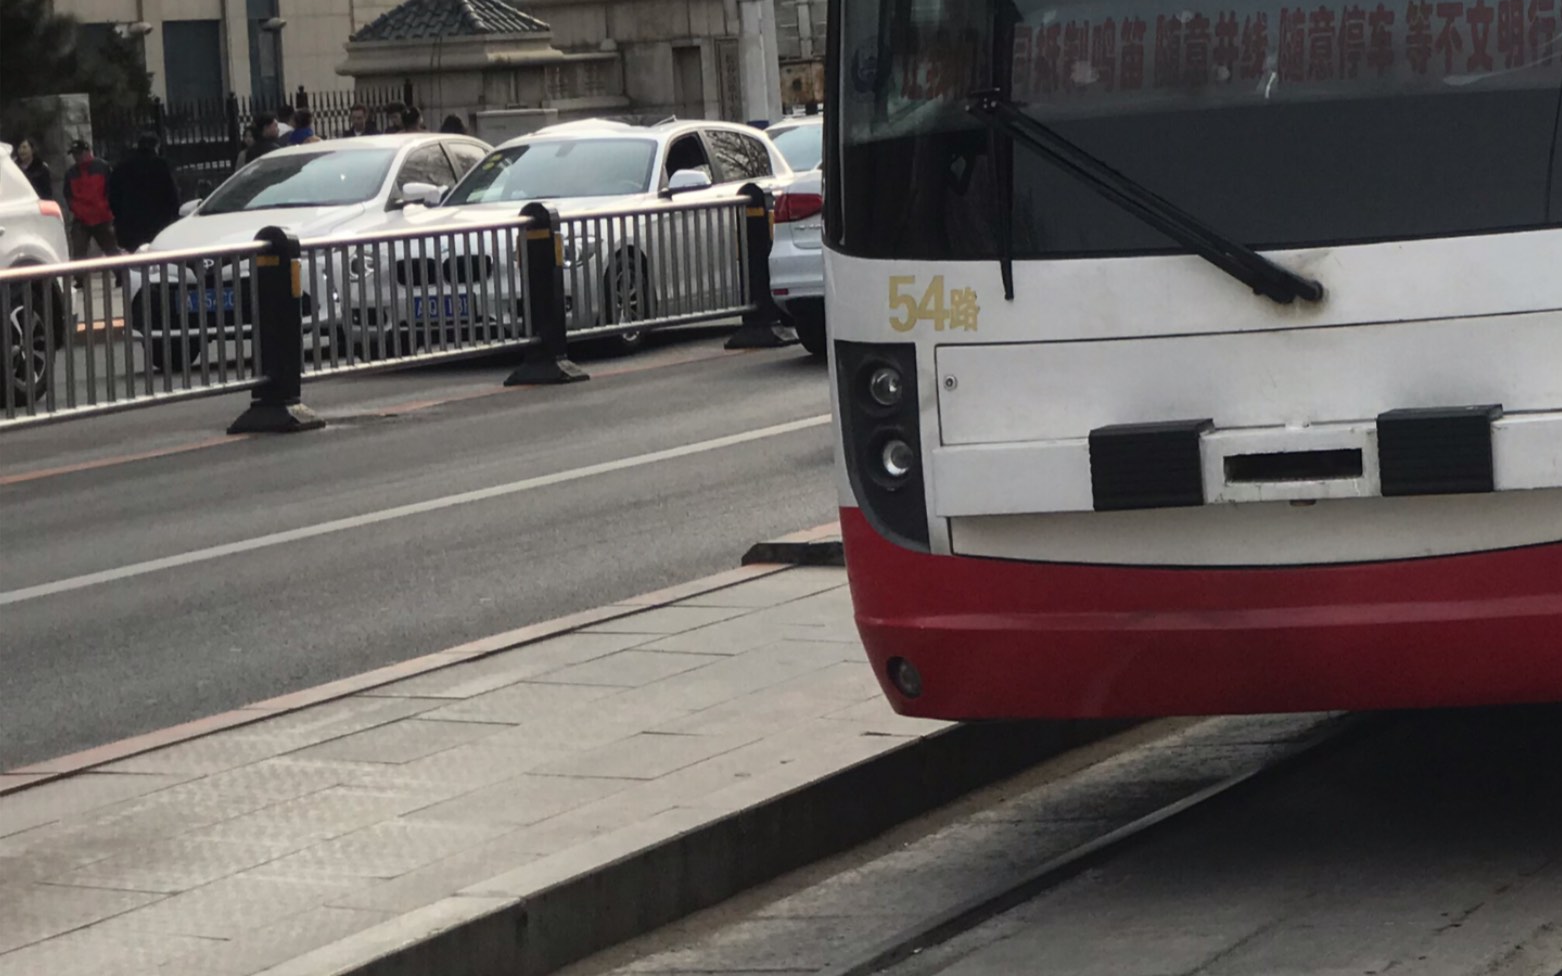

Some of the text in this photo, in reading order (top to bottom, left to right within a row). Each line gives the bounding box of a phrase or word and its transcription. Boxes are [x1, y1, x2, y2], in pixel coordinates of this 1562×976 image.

[1155, 9, 1268, 91] 随意并线
[1278, 2, 1396, 83] 随意停车
[888, 274, 981, 333] 54路
